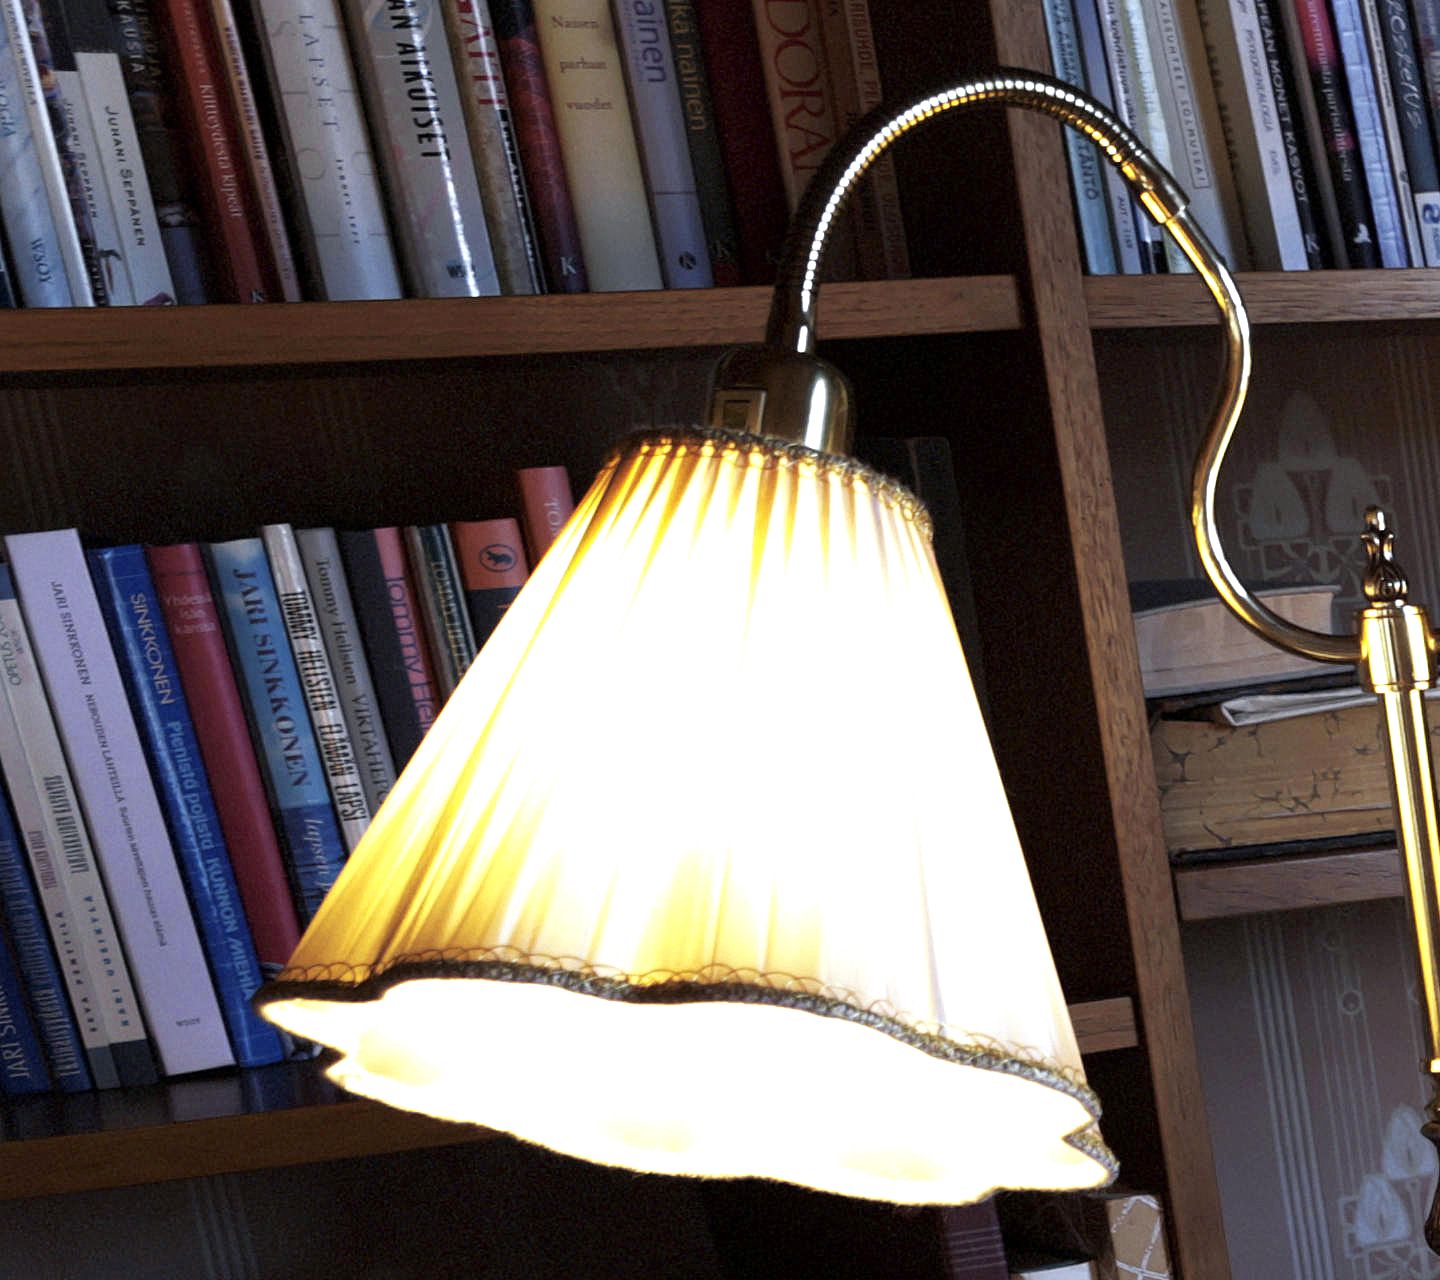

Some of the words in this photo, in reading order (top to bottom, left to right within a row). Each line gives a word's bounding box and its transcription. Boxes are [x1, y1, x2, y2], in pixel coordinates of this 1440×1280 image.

[300, 14, 341, 129] LAPSET
[396, 42, 452, 160] AIKUISET
[676, 41, 710, 131] nainen
[1269, 50, 1291, 125] MONET
[1285, 128, 1308, 202] KASVOT
[105, 104, 128, 163] JUHANI
[51, 579, 70, 608] JARI
[59, 609, 92, 686] SINKKONEN
[313, 556, 344, 619] Tommy
[330, 620, 360, 685] Hellsten
[388, 575, 428, 676] Tommy
[231, 564, 268, 629] JARI
[250, 630, 313, 789] SINKKONEN
[280, 589, 314, 645] TOMMY
[299, 648, 336, 713] HELLSTEN
[322, 719, 356, 777] ELÄMÄN
[341, 779, 371, 823] LAPSI
[131, 590, 176, 705] SINKKONEN
[165, 719, 199, 792] Pienistä
[183, 791, 216, 852] pojista
[202, 857, 237, 935] KUNNON
[5, 1022, 31, 1082] JARI
